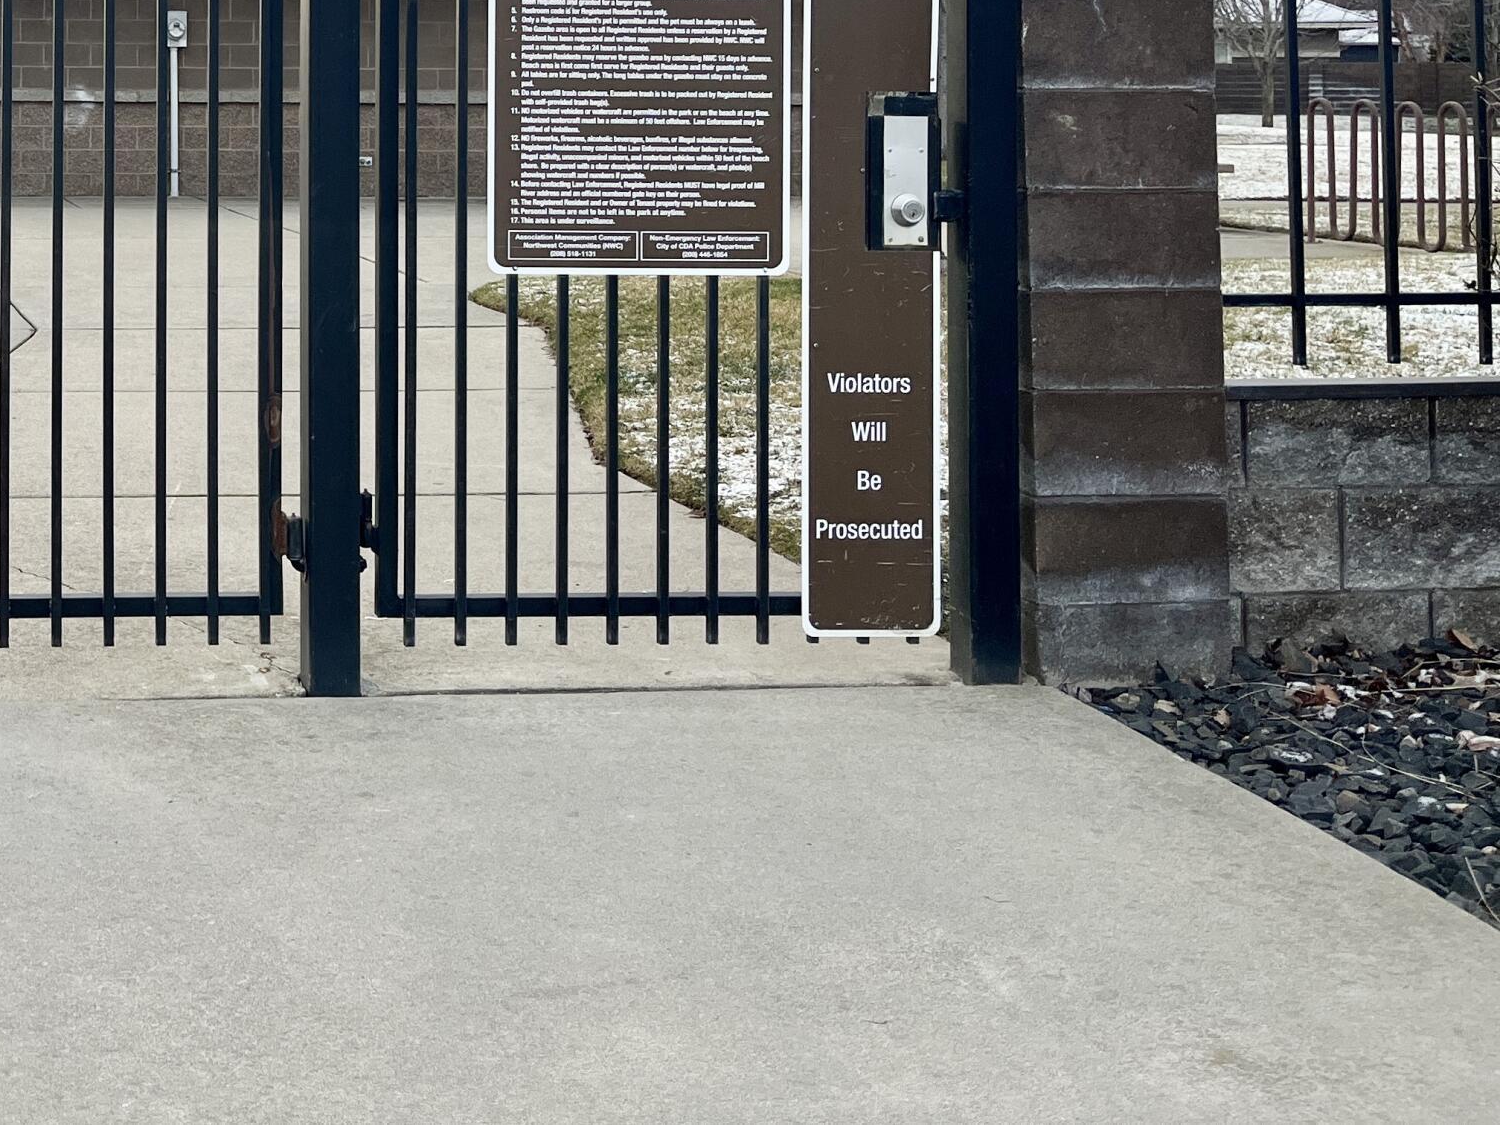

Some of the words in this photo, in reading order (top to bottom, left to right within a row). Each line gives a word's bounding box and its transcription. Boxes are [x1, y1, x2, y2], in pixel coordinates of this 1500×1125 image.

[554, 234, 597, 243] Management
[828, 373, 910, 393] Violators
[852, 422, 886, 441] Will
[858, 471, 881, 490] Be
[816, 519, 922, 539] Prosecuted
